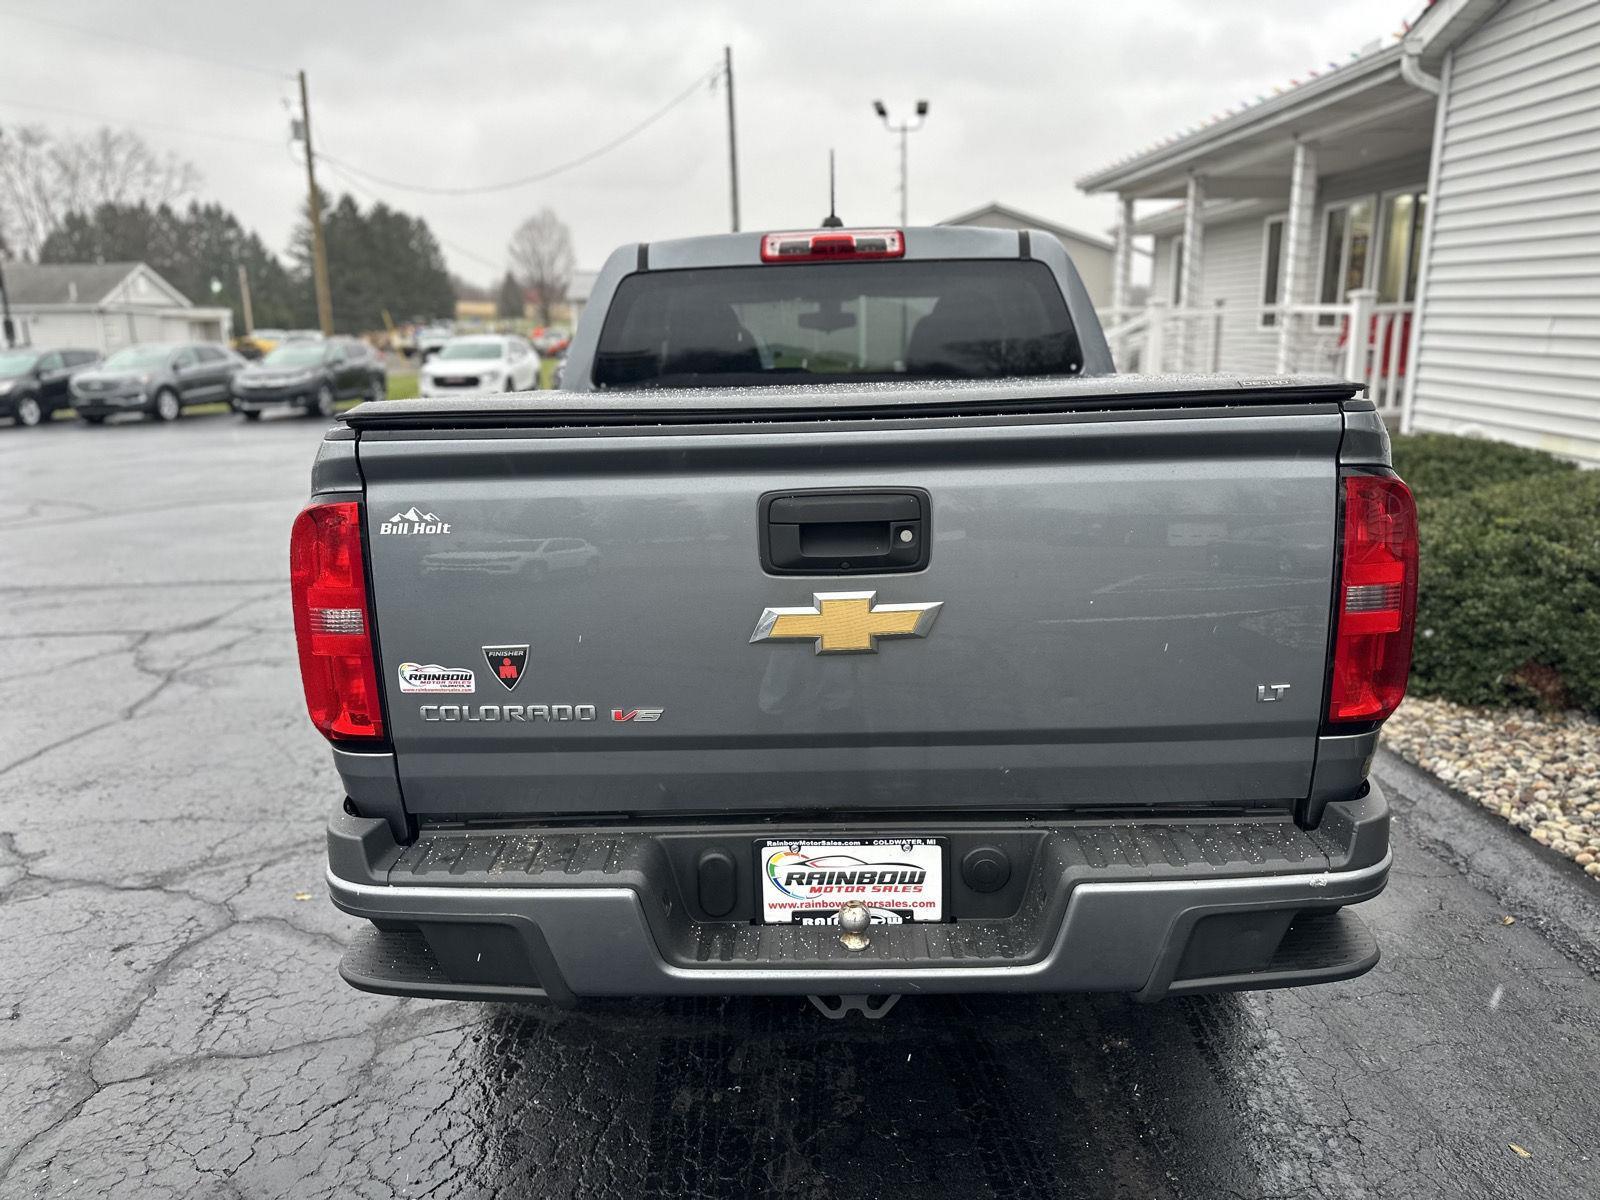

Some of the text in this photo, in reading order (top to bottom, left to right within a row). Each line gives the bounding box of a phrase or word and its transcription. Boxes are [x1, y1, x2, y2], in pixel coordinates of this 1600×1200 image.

[380, 522, 451, 535] Bill Holt
[1256, 683, 1291, 702] LT
[419, 704, 597, 723] COLORADO
[610, 708, 664, 723] V6
[784, 871, 926, 886] RAINBOW
[809, 885, 923, 893] MOTOR SALES
